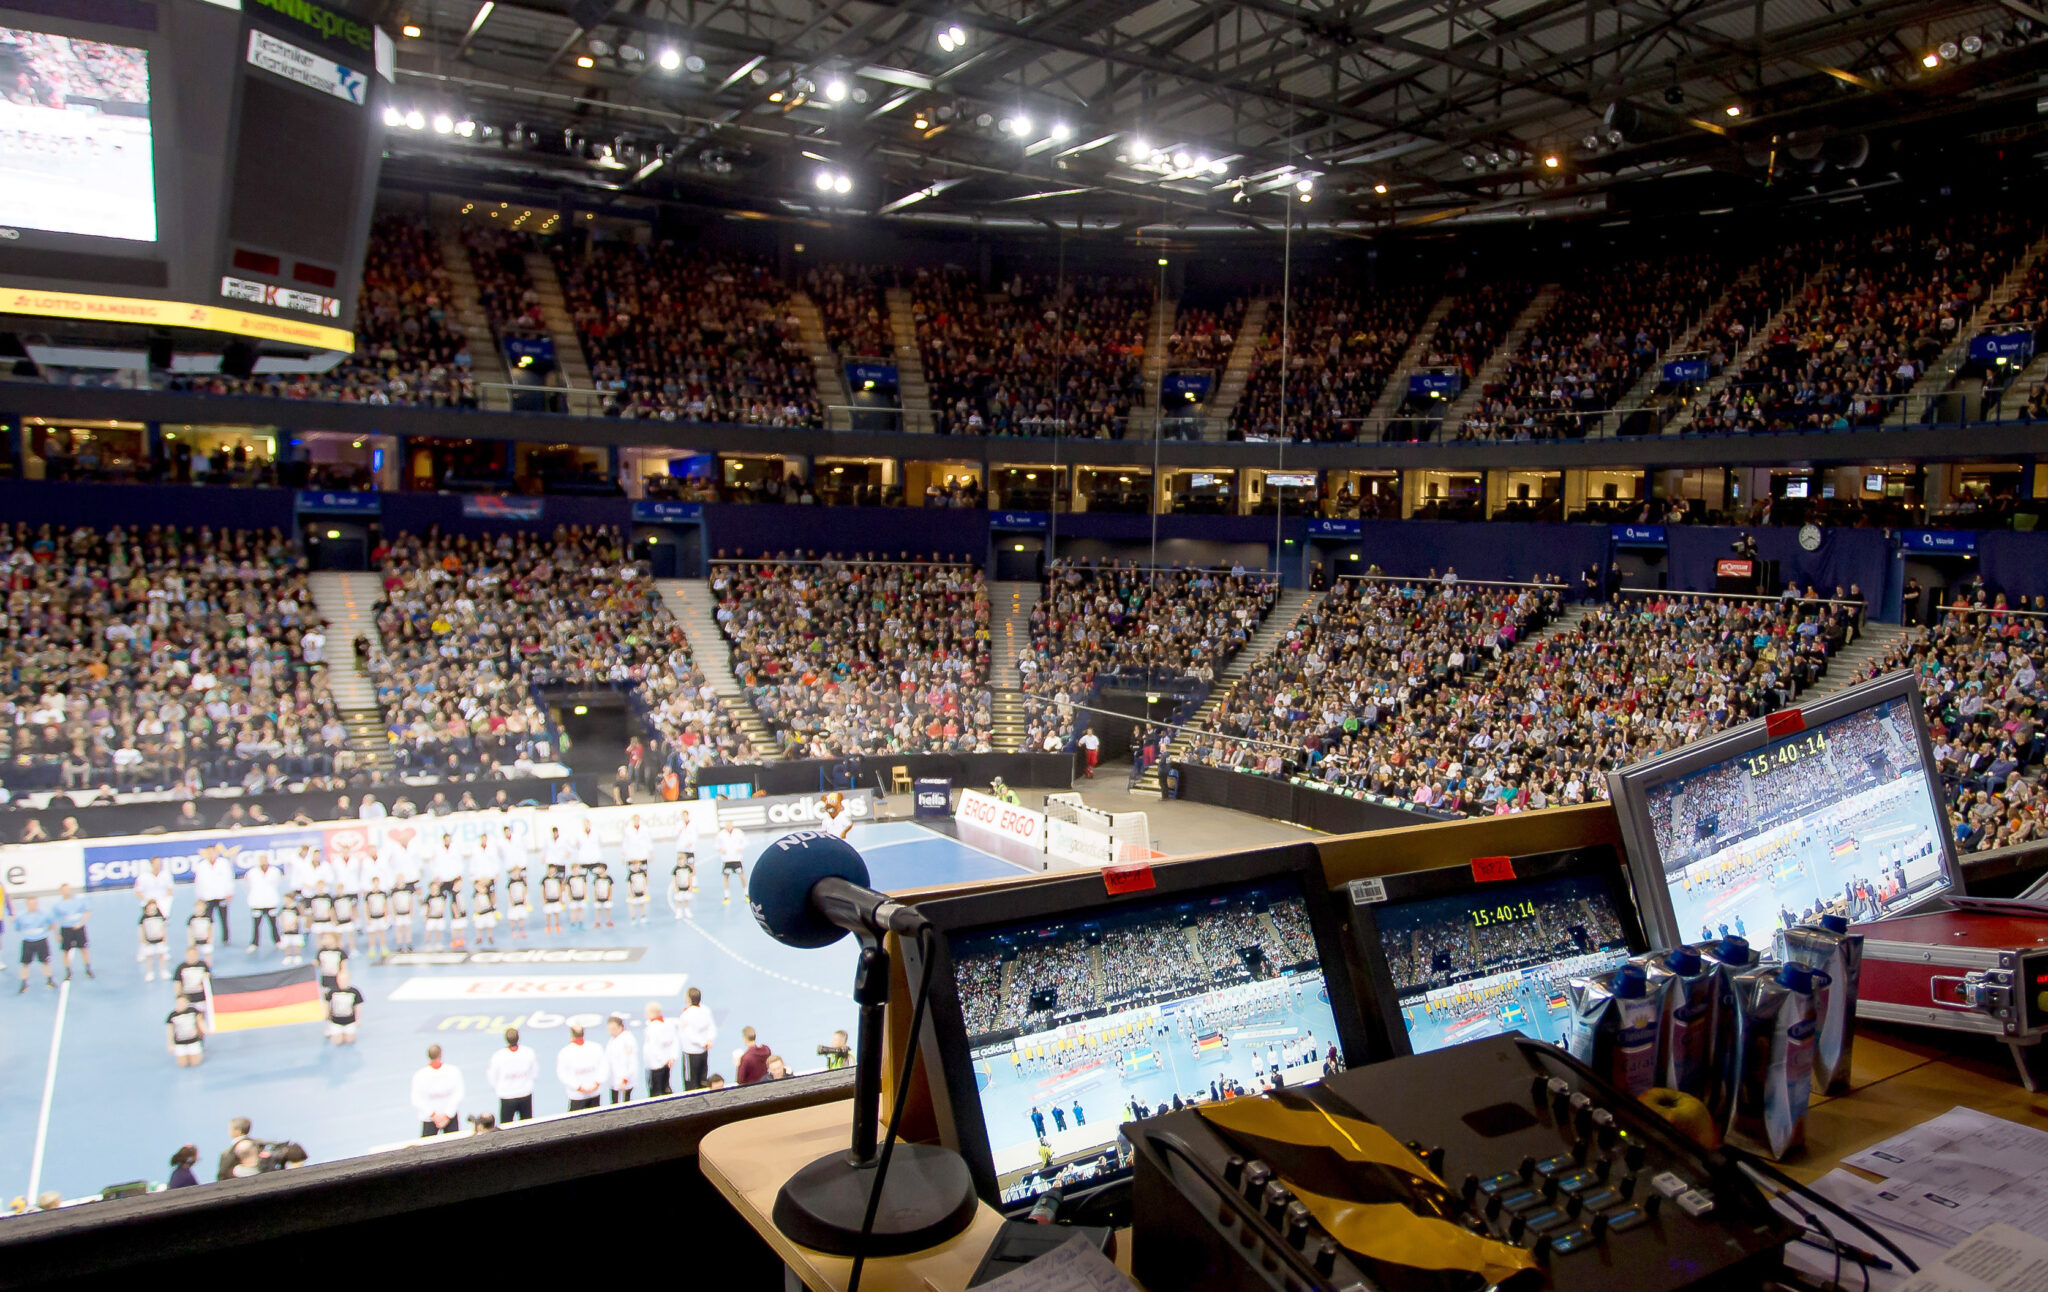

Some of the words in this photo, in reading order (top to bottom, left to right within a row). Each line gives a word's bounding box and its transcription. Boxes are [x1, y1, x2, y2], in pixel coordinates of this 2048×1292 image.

[34, 298, 82, 312] LOTTO
[86, 302, 158, 317] HAMBURG
[1748, 732, 1826, 777] 15:40:14
[963, 797, 997, 824] ERGO
[1000, 809, 1035, 838] ERGO
[1471, 900, 1536, 928] 15:40:14
[470, 949, 630, 964] adidas
[465, 980, 616, 994] ERGO
[981, 1042, 1014, 1056] adidas
